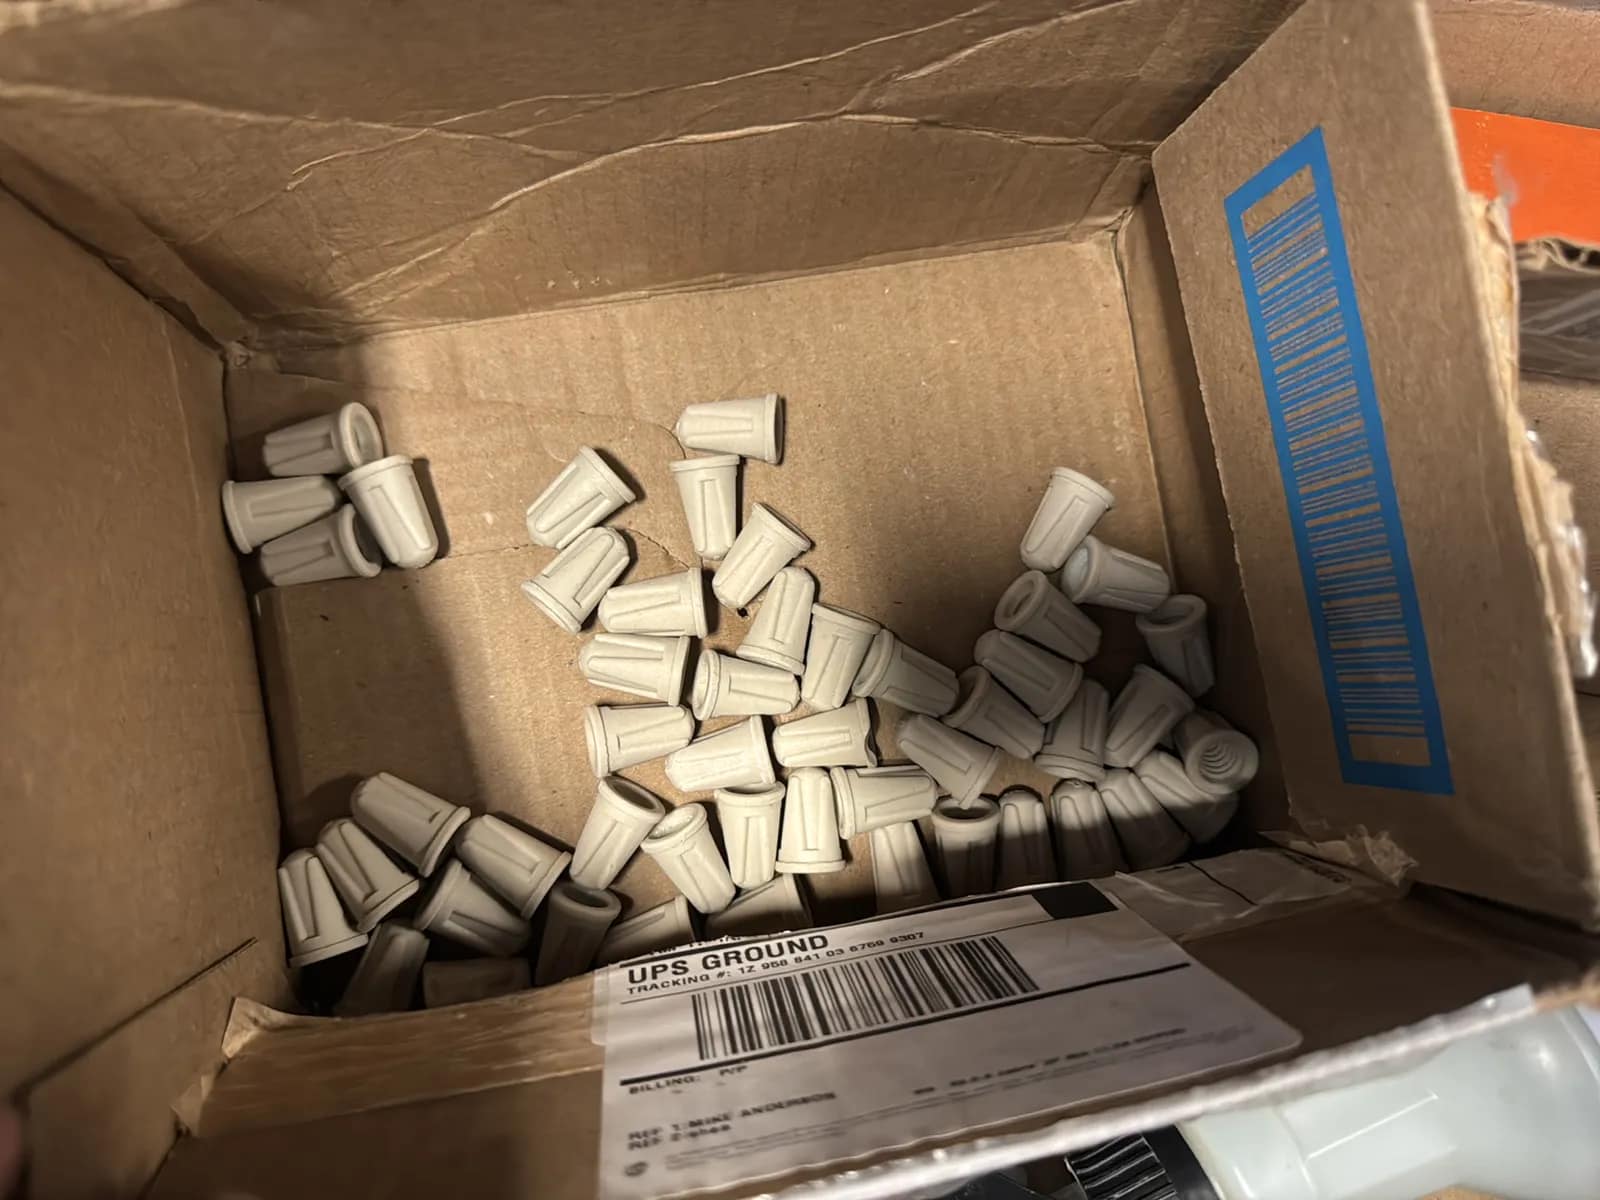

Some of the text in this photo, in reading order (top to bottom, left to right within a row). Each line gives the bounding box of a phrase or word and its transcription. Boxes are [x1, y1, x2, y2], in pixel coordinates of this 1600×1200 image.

[628, 959, 690, 984] UPS
[701, 936, 829, 970] GROUND
[626, 974, 710, 995] TRACKING
